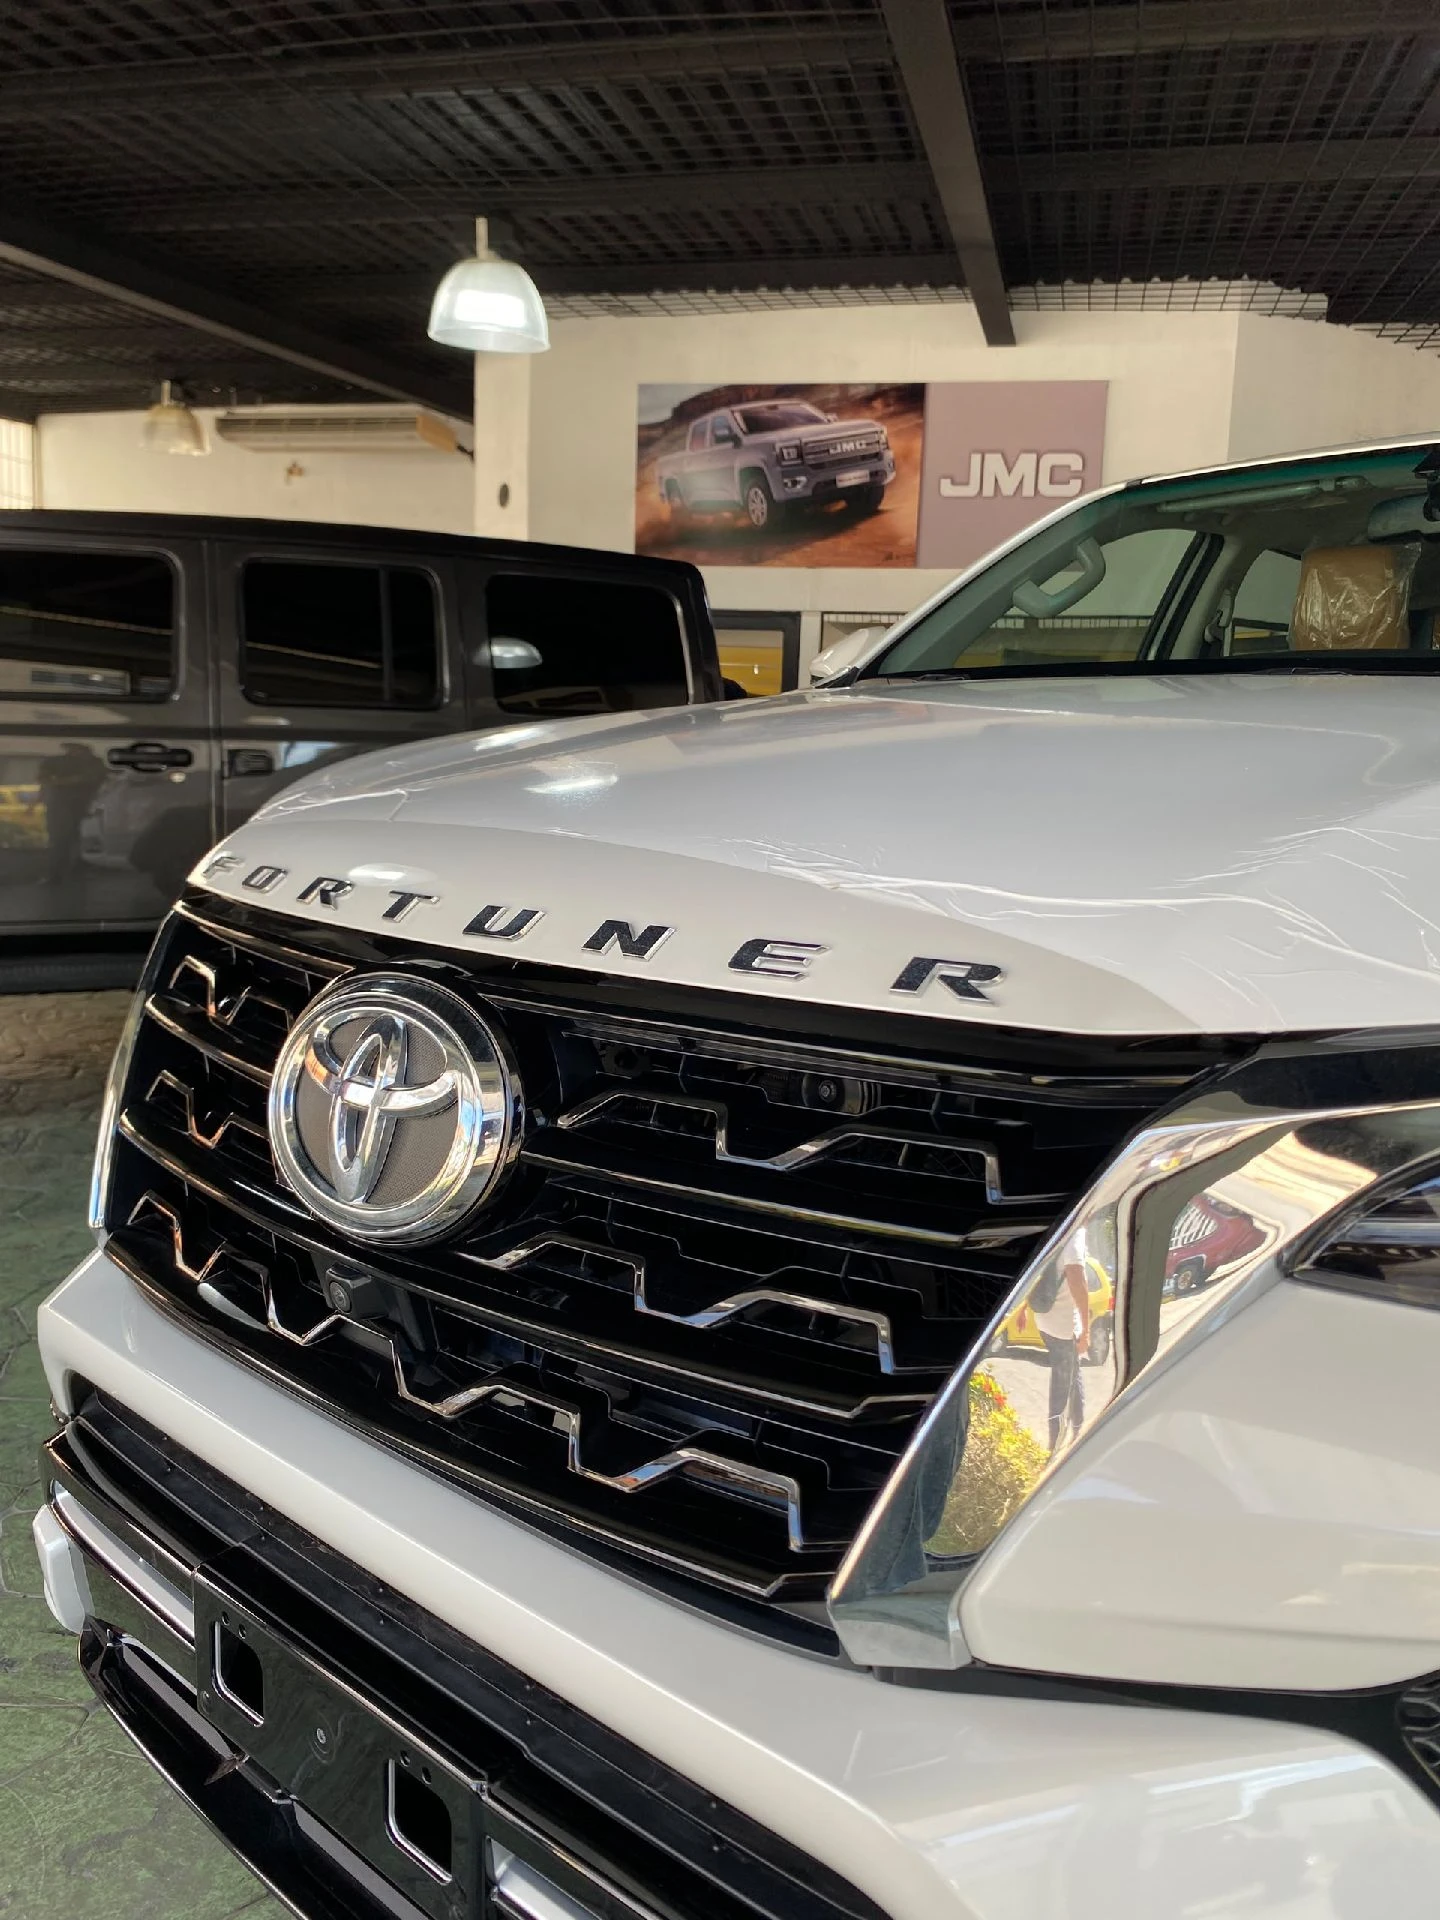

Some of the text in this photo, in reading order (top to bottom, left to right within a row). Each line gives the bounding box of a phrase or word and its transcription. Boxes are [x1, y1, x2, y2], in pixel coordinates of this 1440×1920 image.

[829, 439, 867, 454] JMC
[939, 452, 1083, 498] JMC
[203, 855, 1005, 1005] FORTUNER
